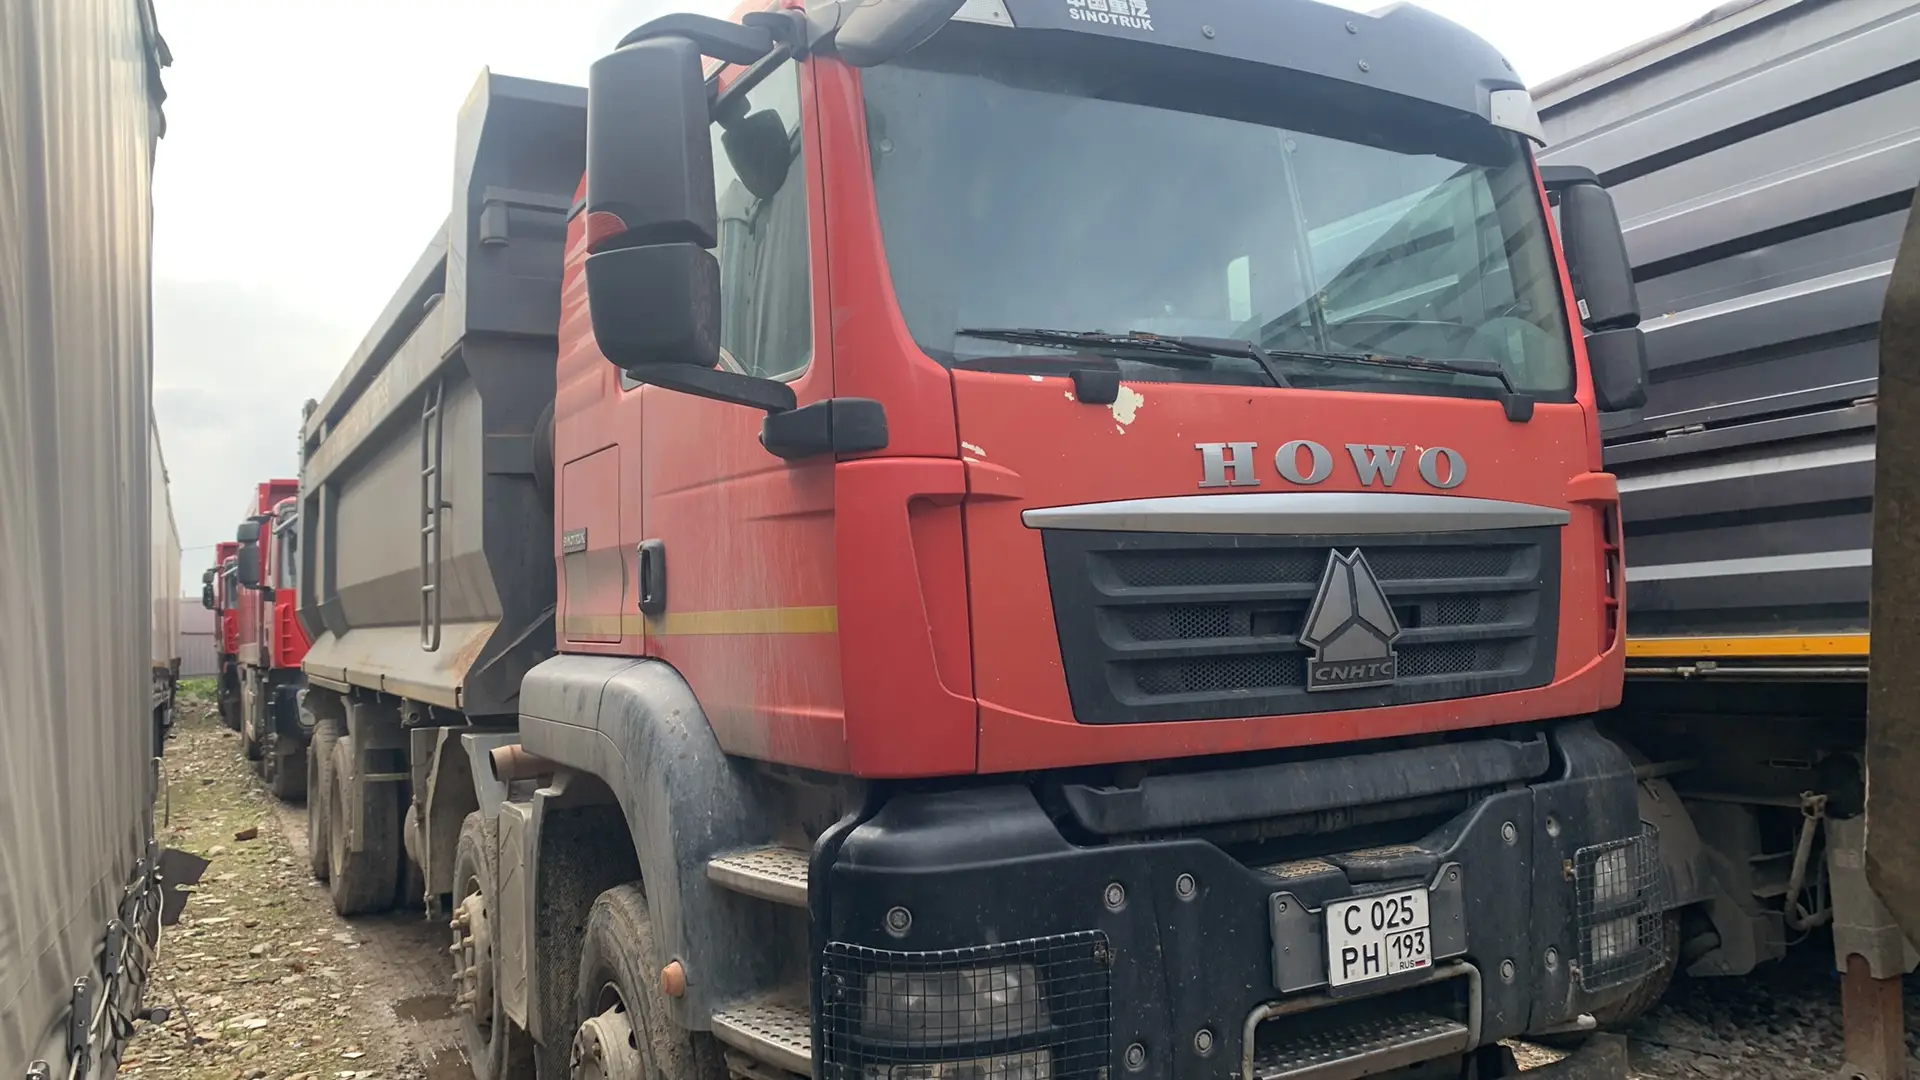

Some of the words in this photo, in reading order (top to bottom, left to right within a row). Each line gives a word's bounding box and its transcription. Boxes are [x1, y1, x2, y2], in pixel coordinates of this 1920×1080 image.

[1069, 8, 1154, 31] SINOTRUK
[1195, 439, 1467, 489] HOWO
[1315, 661, 1393, 680] CNHTC
[1371, 895, 1414, 931] 025
[1392, 931, 1425, 959] 193
[1400, 960, 1415, 970] RUS
